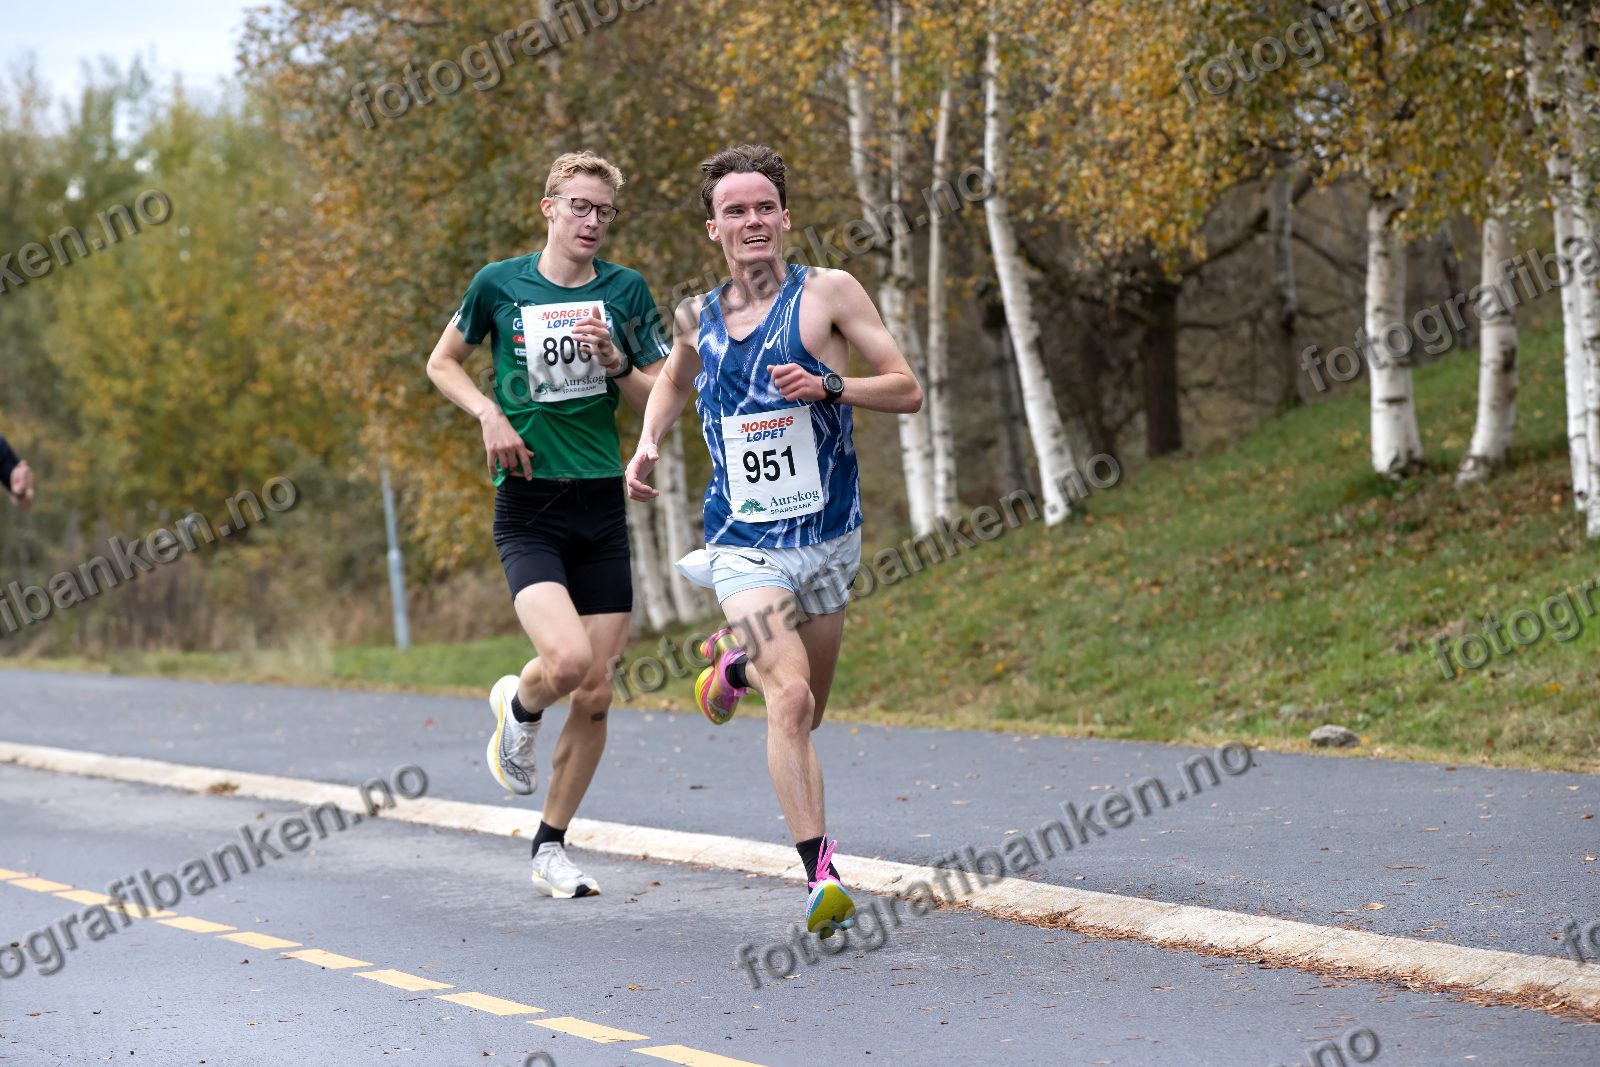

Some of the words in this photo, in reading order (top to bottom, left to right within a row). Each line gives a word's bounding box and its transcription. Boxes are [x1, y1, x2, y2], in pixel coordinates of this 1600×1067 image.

[542, 308, 590, 320] NORGES
[543, 335, 592, 366] 806
[562, 375, 605, 388] Aurskog
[740, 415, 794, 433] NORGES
[746, 428, 786, 442] LØPET
[742, 445, 796, 483] 951
[770, 490, 820, 508] Aurskog
[770, 502, 812, 515] SPAREBANK
